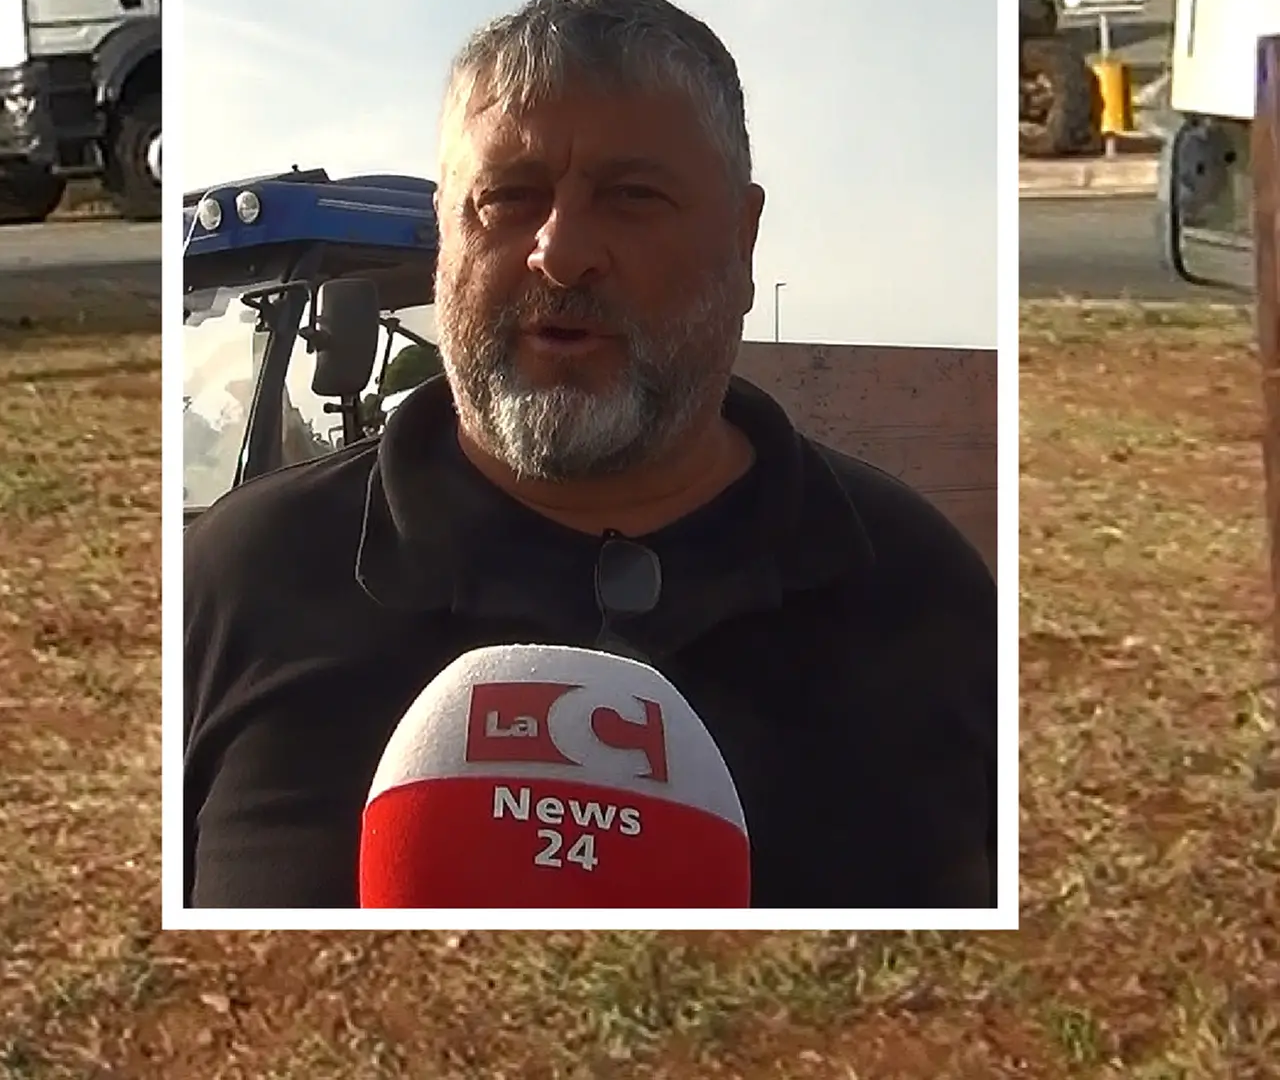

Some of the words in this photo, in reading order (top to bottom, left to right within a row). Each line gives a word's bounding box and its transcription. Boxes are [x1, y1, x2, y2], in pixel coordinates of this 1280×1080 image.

[485, 710, 539, 739] La
[492, 785, 642, 837] News
[534, 829, 598, 871] 24
